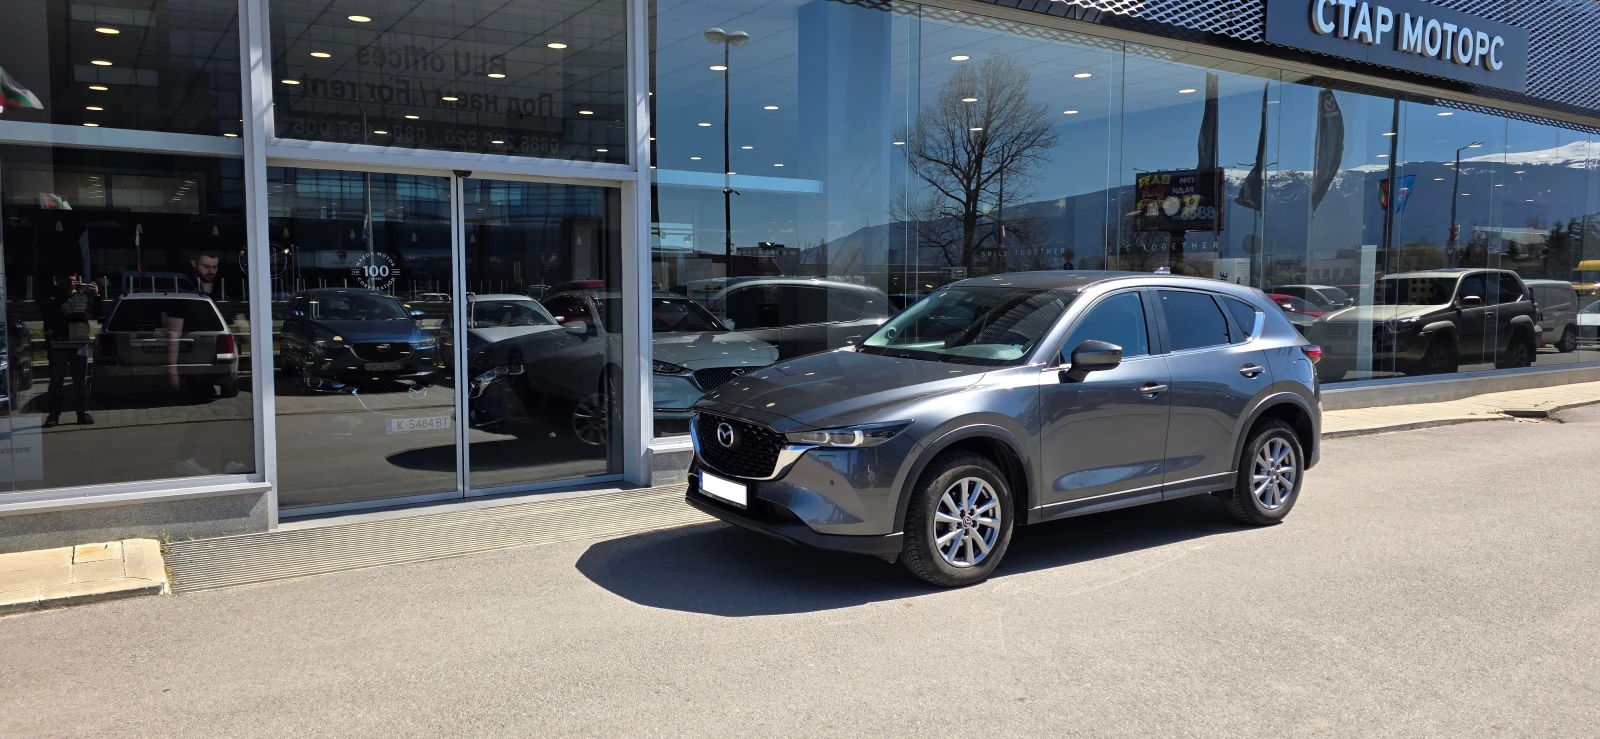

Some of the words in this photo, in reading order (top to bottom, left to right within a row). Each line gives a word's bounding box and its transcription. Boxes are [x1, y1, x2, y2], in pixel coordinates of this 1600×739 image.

[1314, 0, 1394, 45] СТАР
[1401, 12, 1505, 71] МОТОРС
[1014, 246, 1066, 257] TOGETHER
[1142, 241, 1220, 253] TOGETHER
[355, 251, 375, 268] MAZDA
[376, 251, 396, 268] MOTOR
[362, 264, 390, 278] 100
[357, 276, 396, 291] CORPORATION
[397, 420, 404, 430] K
